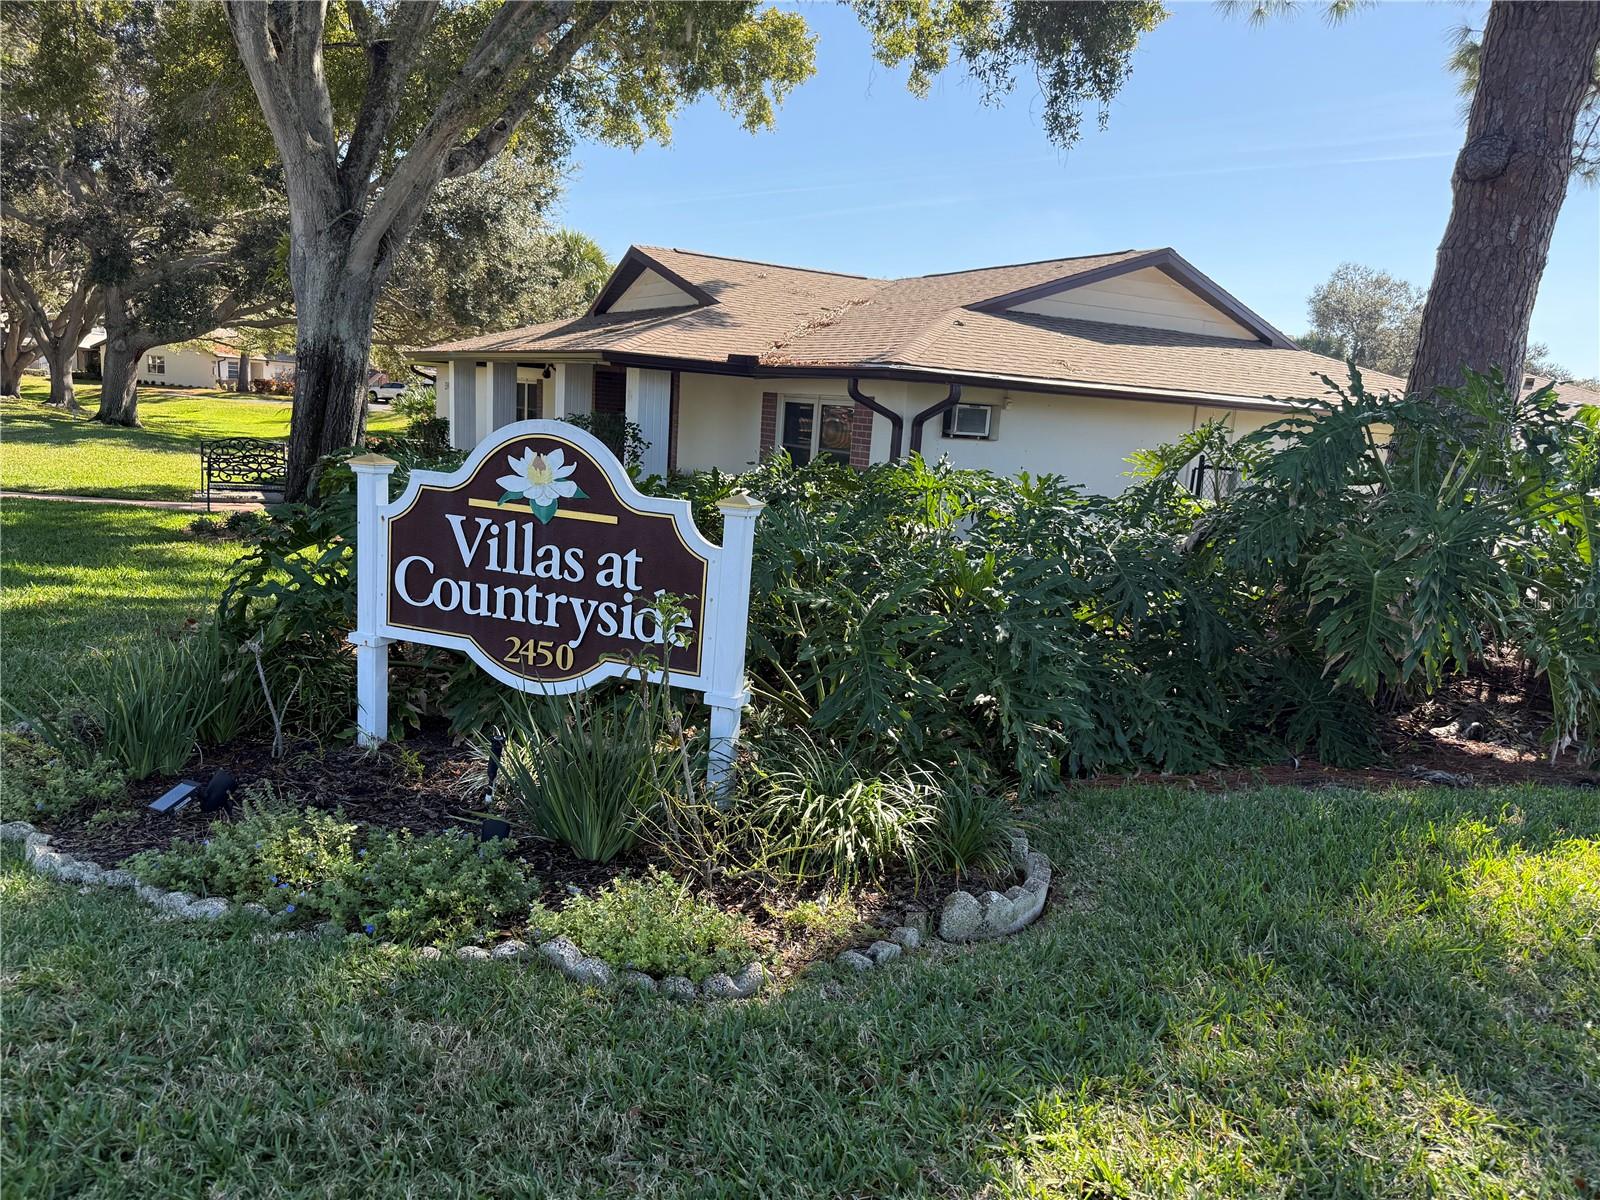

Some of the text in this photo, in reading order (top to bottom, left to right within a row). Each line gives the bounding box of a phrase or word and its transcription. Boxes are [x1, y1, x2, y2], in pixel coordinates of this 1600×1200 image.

[445, 513, 643, 591] Villas at
[395, 555, 694, 649] Countryside
[503, 636, 575, 671] 2450
